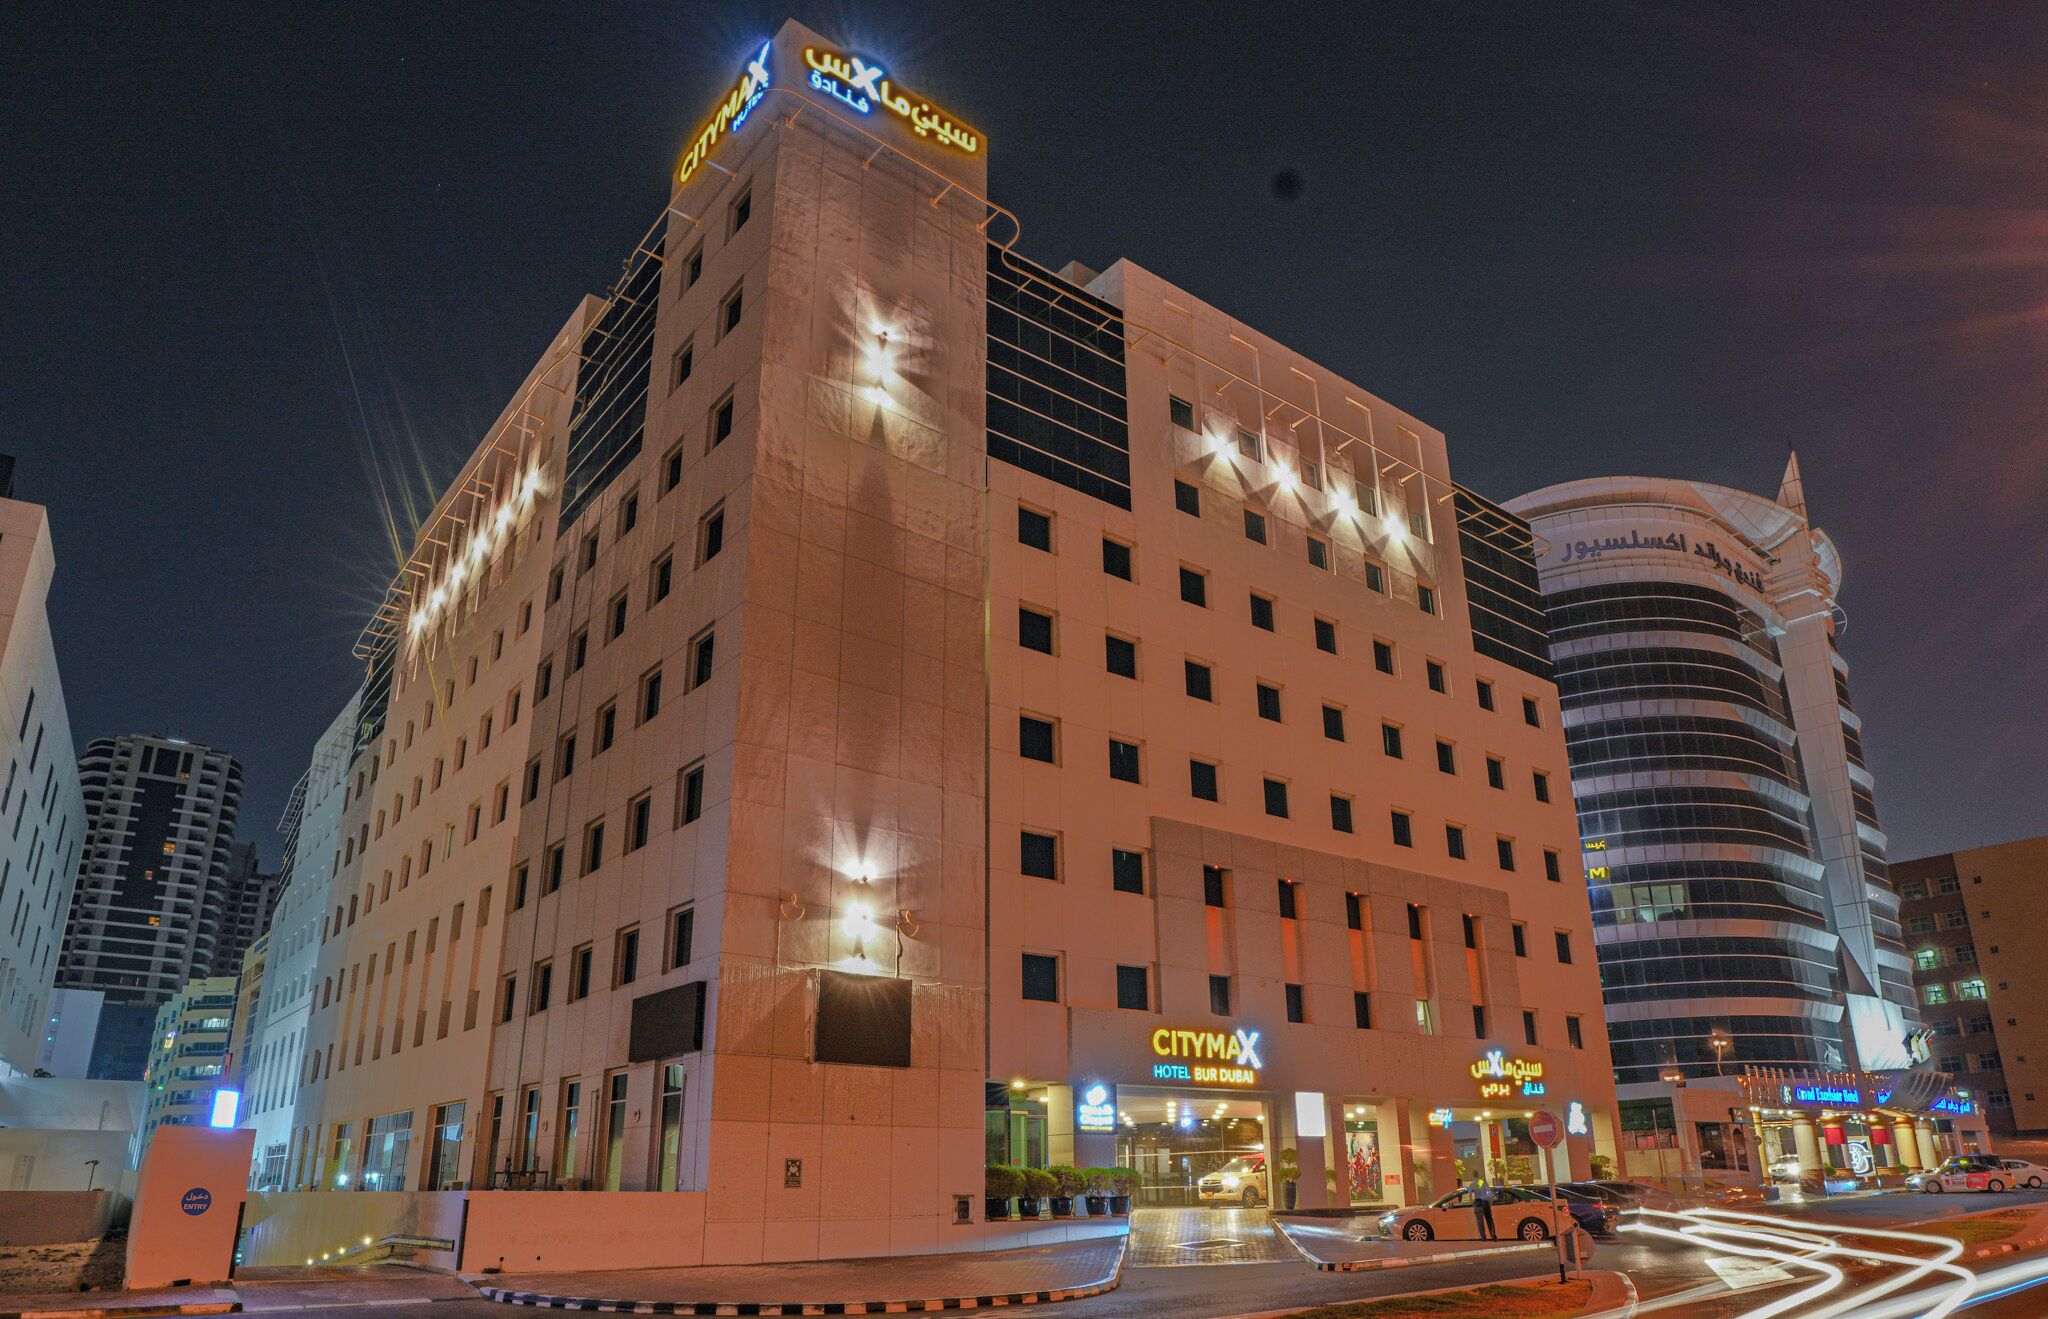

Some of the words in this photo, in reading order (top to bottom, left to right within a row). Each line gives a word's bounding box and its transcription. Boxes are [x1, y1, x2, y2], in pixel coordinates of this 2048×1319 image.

[680, 41, 770, 182] CITYMAX
[811, 69, 869, 114] فنادق
[1153, 1029, 1262, 1069] CITYMAX
[1153, 1065, 1191, 1079] HOTEL
[1194, 1067, 1218, 1081] BUR
[1219, 1069, 1254, 1083] DUBAI
